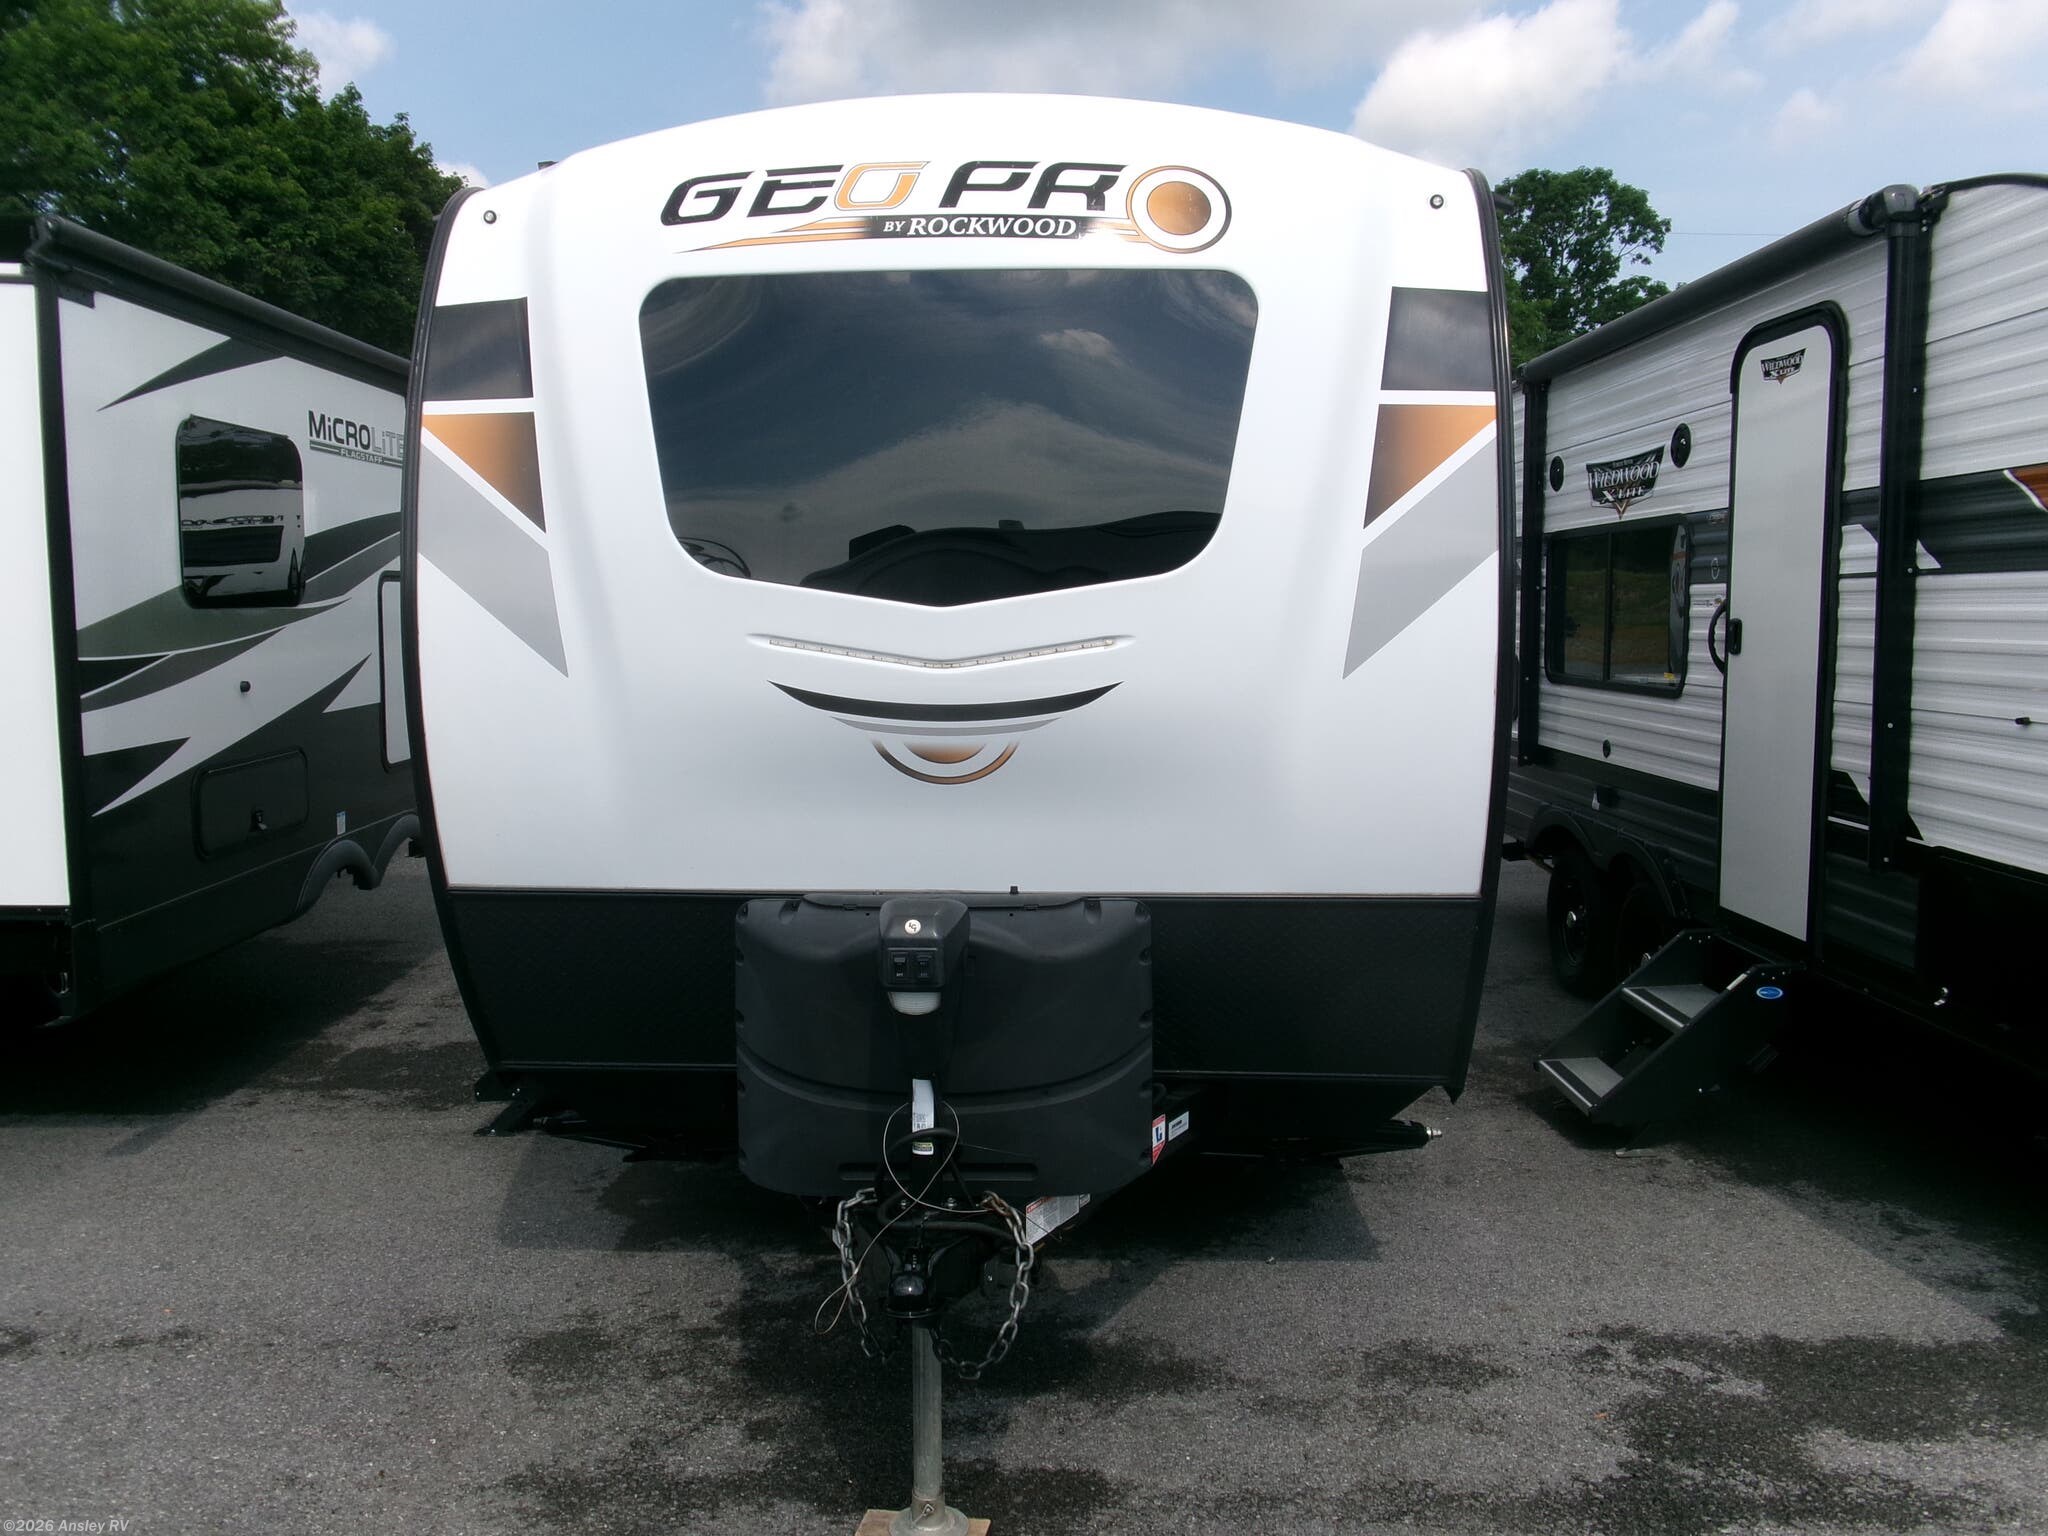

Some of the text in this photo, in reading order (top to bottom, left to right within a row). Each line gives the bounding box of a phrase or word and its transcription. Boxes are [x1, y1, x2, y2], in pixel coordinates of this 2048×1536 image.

[660, 161, 931, 226] GEO
[883, 216, 1077, 237] BY ROCKWOOD
[340, 448, 384, 464] FLAGSTAFF
[1588, 461, 1660, 489] WILDWOOD
